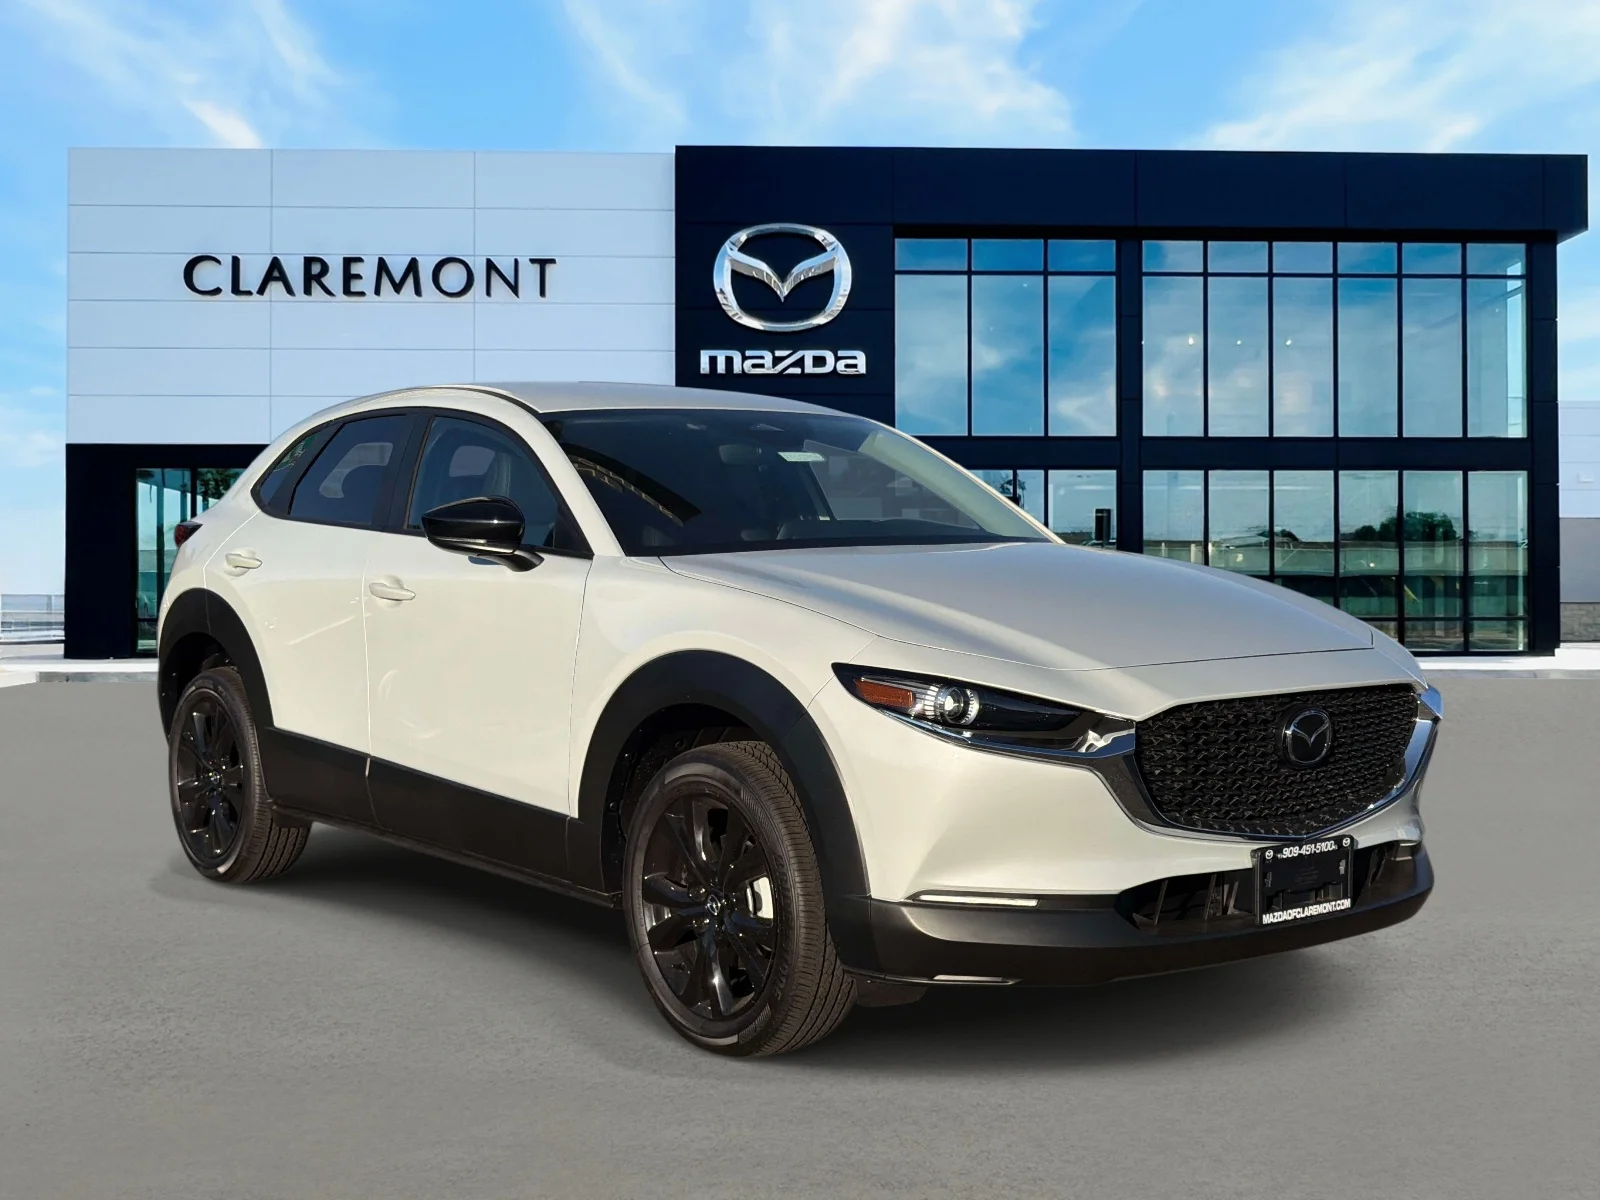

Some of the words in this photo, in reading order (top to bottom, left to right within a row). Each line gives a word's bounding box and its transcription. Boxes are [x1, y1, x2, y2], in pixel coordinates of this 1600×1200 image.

[183, 254, 557, 299] CLAREMONT
[1282, 840, 1335, 859] 909-451-5100
[1262, 898, 1351, 925] MAZDAOFCLAREMONT.COM
